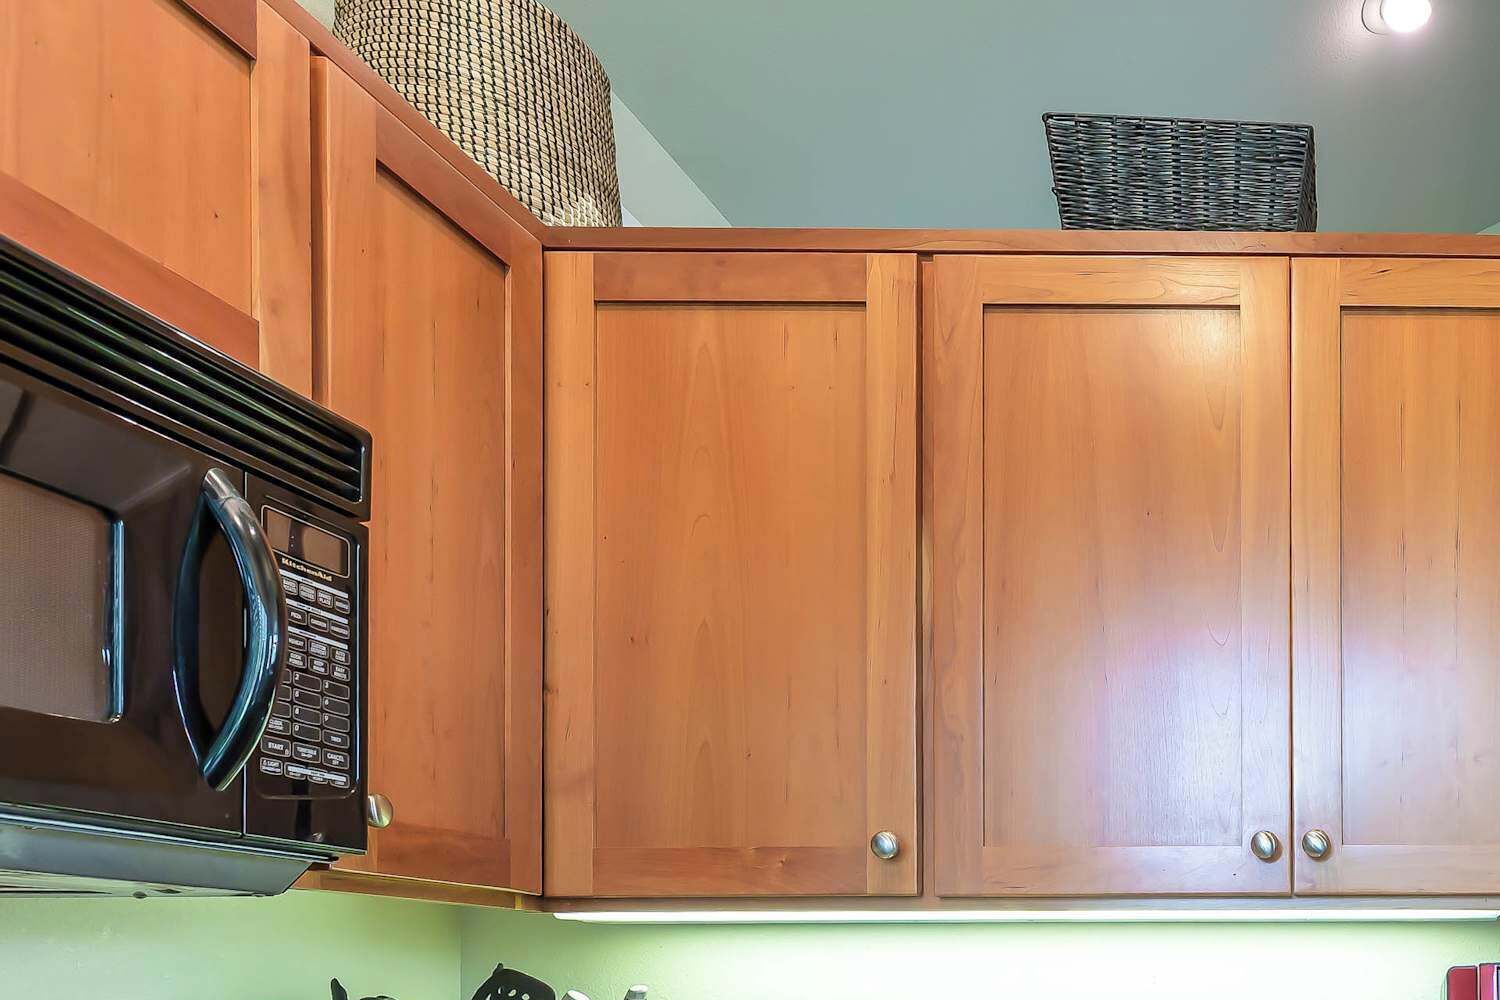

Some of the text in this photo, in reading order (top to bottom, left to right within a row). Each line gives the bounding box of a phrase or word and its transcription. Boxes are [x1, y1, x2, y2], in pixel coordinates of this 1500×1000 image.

[281, 557, 333, 582] KitchenAid
[294, 673, 300, 681] 2
[268, 741, 285, 751] START
[326, 752, 345, 763] CANCEL
